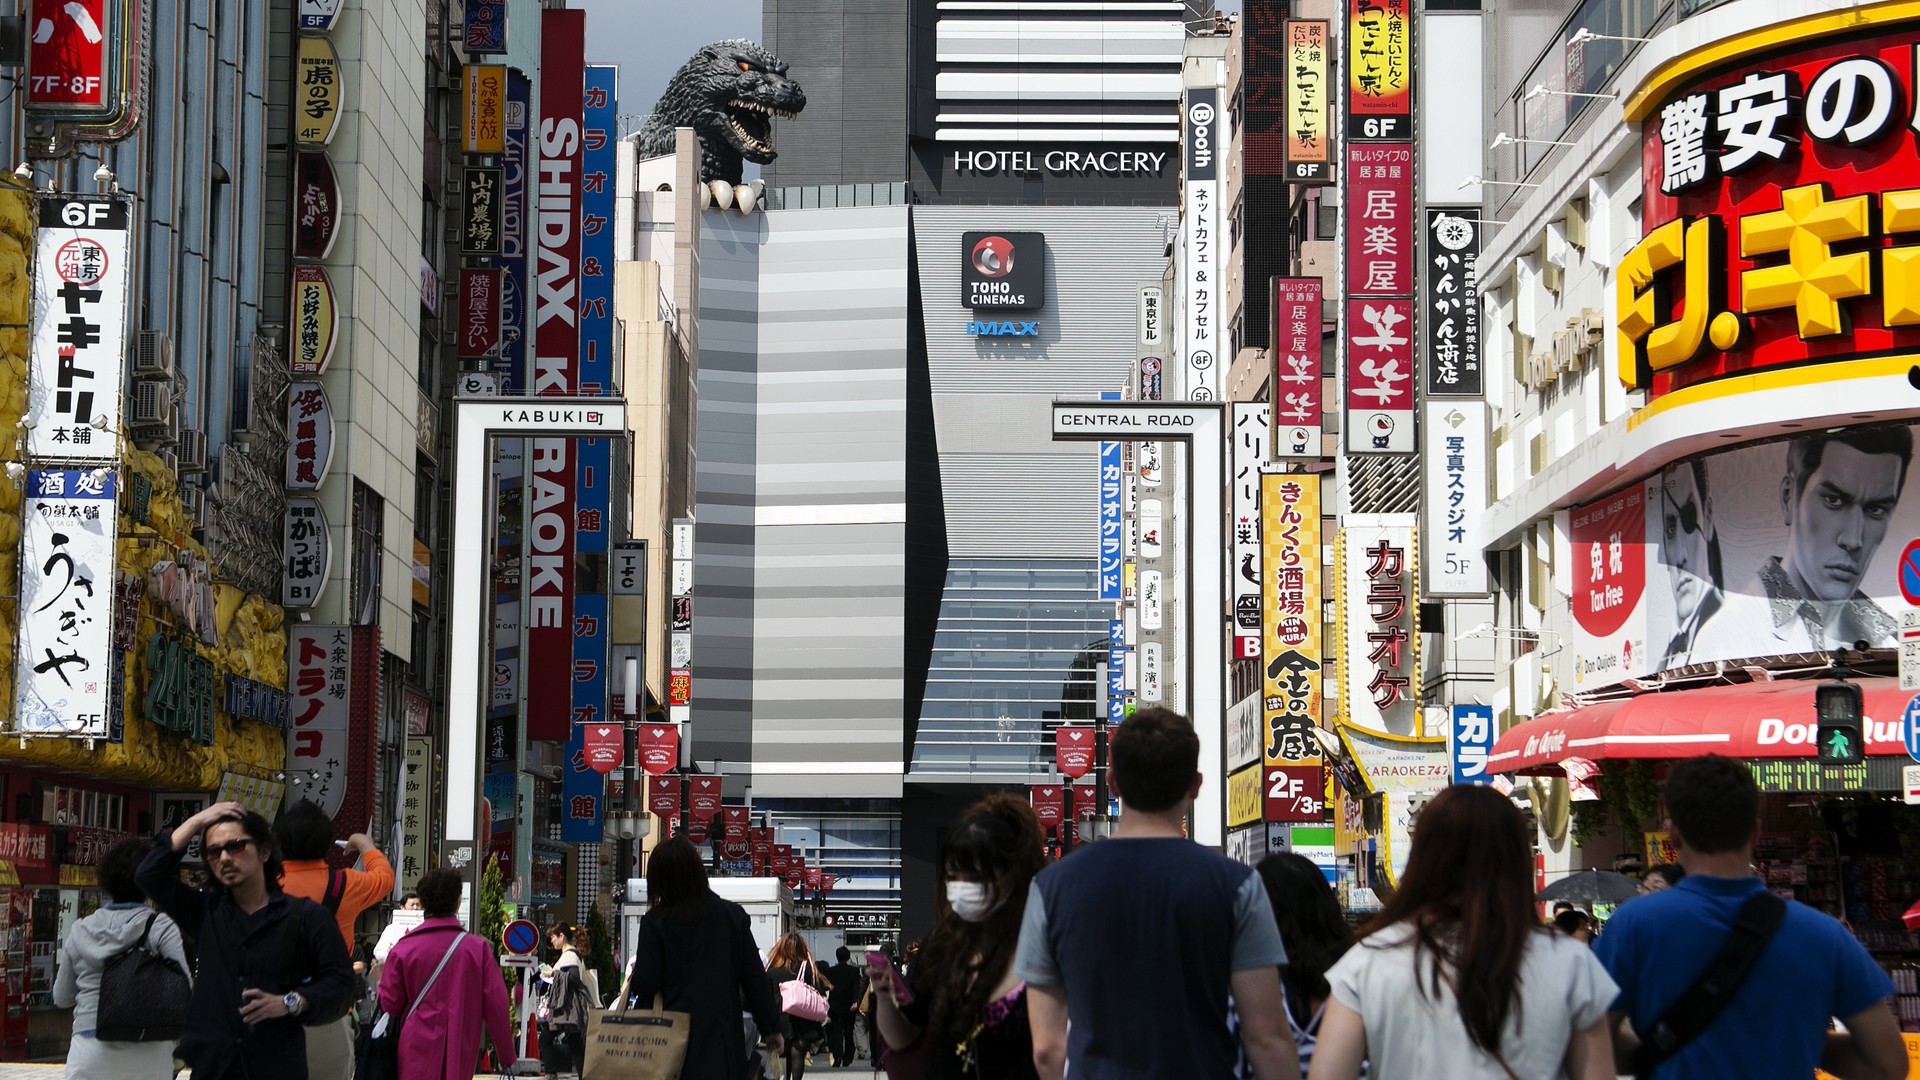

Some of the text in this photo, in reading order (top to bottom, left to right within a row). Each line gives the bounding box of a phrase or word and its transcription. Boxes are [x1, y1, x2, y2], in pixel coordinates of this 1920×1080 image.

[307, 16, 324, 26] 5F
[1294, 26, 1306, 62] だいにんぐ
[1309, 26, 1321, 62] 炭火焼
[303, 66, 333, 119] 虎の子
[1363, 119, 1396, 137] 6F
[1661, 42, 1920, 194] 驚安の
[301, 128, 325, 138] 4F
[1189, 102, 1215, 168] Booth
[954, 151, 1166, 171] HOTEL GRACERY
[1351, 150, 1409, 162] 新しいタイプの
[1296, 164, 1318, 177] 6F
[1359, 166, 1401, 178] 居酒屋
[61, 203, 111, 227] 6F
[301, 183, 320, 227] カラオケ
[537, 117, 579, 329] SHIDAX
[474, 241, 487, 249] 5F
[1362, 190, 1398, 291] 居楽屋
[82, 246, 101, 279] 東京
[970, 282, 1010, 294] TOHO
[970, 295, 1025, 305] CINEMAS
[301, 285, 320, 361] お好み焼き
[468, 274, 490, 348] 焼肉屋さかい
[1145, 297, 1157, 340] 東京ビル
[966, 321, 1038, 336] IMAX
[1291, 305, 1307, 352] 居楽屋
[57, 281, 103, 424] ヤキトリ
[1195, 356, 1208, 365] 8F
[294, 363, 317, 372] 2階
[1061, 415, 1194, 426] CENTRAL ROAD
[51, 427, 92, 445] 本舗
[38, 472, 104, 496] 酒処
[530, 357, 568, 628] KRAOKE
[1446, 436, 1466, 543] 写真スタジオ
[289, 518, 316, 579] かっぱ
[1278, 481, 1305, 615] きんくら酒場
[1444, 553, 1470, 574] 5F
[290, 586, 311, 598] B1
[1590, 585, 1624, 613] Tax Free
[34, 533, 101, 691] うさぎや
[1365, 540, 1410, 710] カラオケ
[1279, 634, 1306, 642] KURA
[328, 630, 348, 700] 大衆酒場
[1584, 654, 1617, 674] Don Quijote
[293, 637, 327, 758] トラノコ
[1267, 650, 1321, 760] 金の蔵
[77, 714, 101, 728] 5F
[1458, 712, 1489, 786] カラ
[1269, 771, 1304, 798] 2F
[1364, 766, 1425, 776] KARAOKE
[597, 1034, 668, 1046] MARC JACOBS
